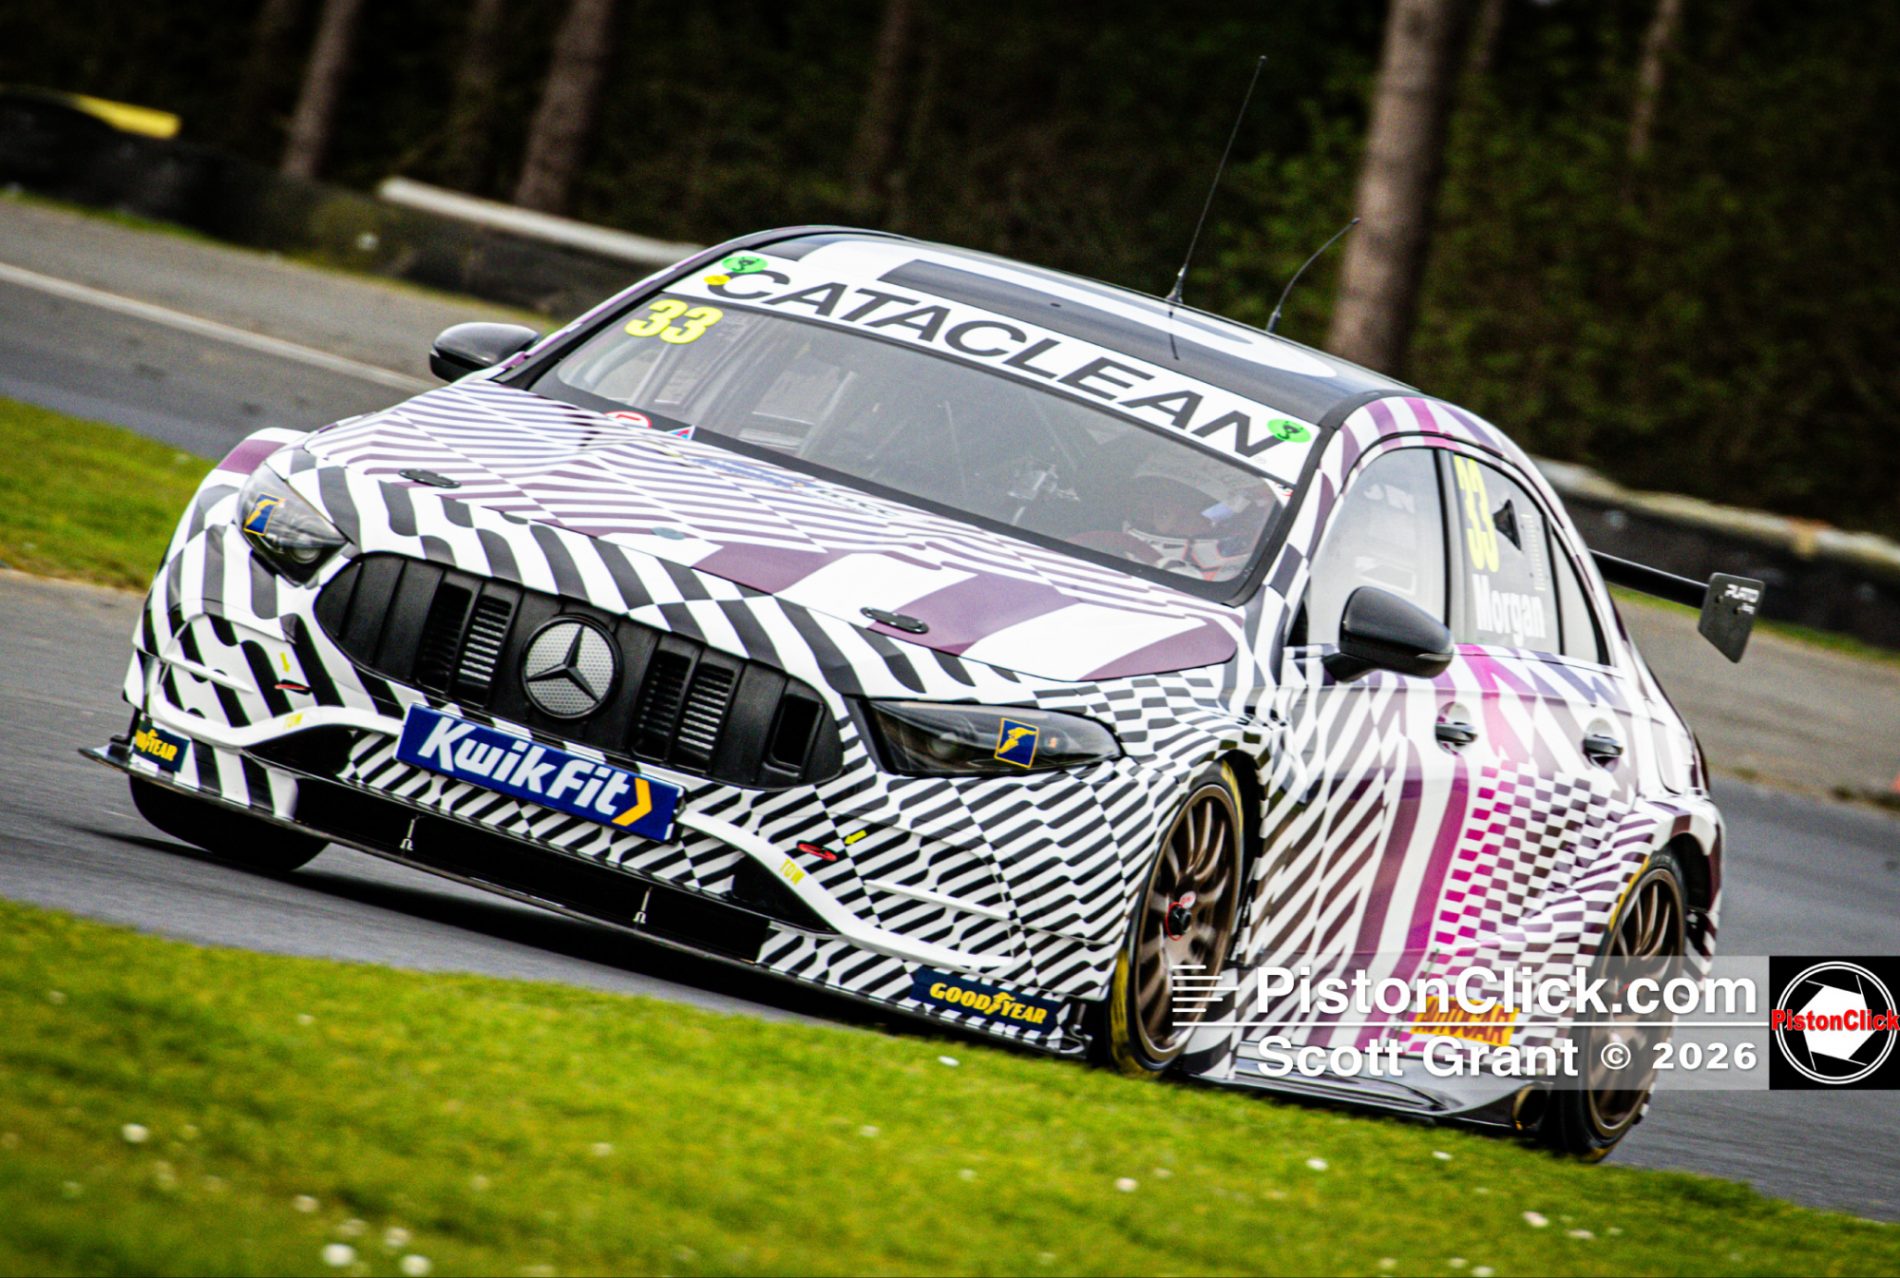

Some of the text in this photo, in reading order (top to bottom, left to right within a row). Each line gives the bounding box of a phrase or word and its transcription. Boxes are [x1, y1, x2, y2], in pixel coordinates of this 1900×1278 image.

[623, 298, 724, 345] 33
[707, 269, 1286, 458] CATACLEAN
[1453, 454, 1500, 573] 33
[1472, 573, 1546, 647] Morgan
[778, 857, 806, 885] TOW
[929, 981, 1048, 1025] GOODYEAR
